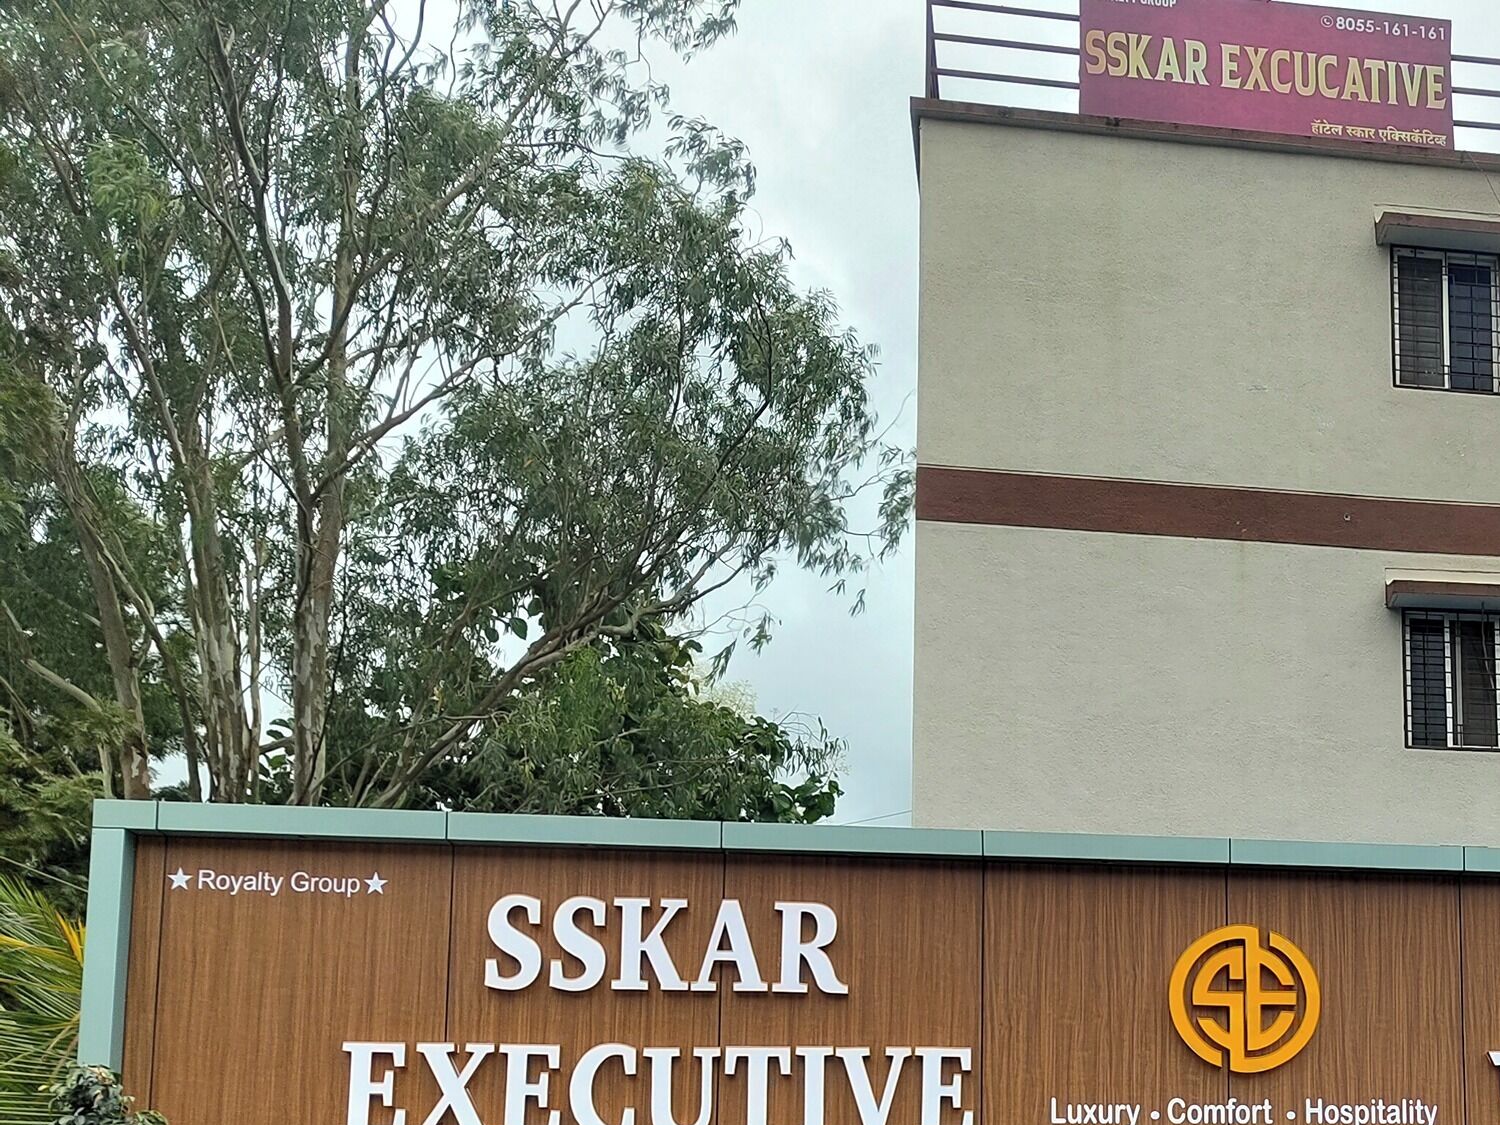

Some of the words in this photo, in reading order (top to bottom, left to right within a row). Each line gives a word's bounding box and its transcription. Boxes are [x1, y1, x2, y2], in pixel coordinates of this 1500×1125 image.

[1335, 16, 1445, 41] 8055-161-161
[1085, 29, 1210, 86] SSKAR
[1220, 43, 1447, 110] EXCUCATIVE
[1346, 125, 1376, 139] स्कार
[198, 869, 284, 896] Royalty
[290, 872, 361, 898] Group
[484, 894, 850, 996] SSKAR
[1166, 1098, 1274, 1125] Comfort
